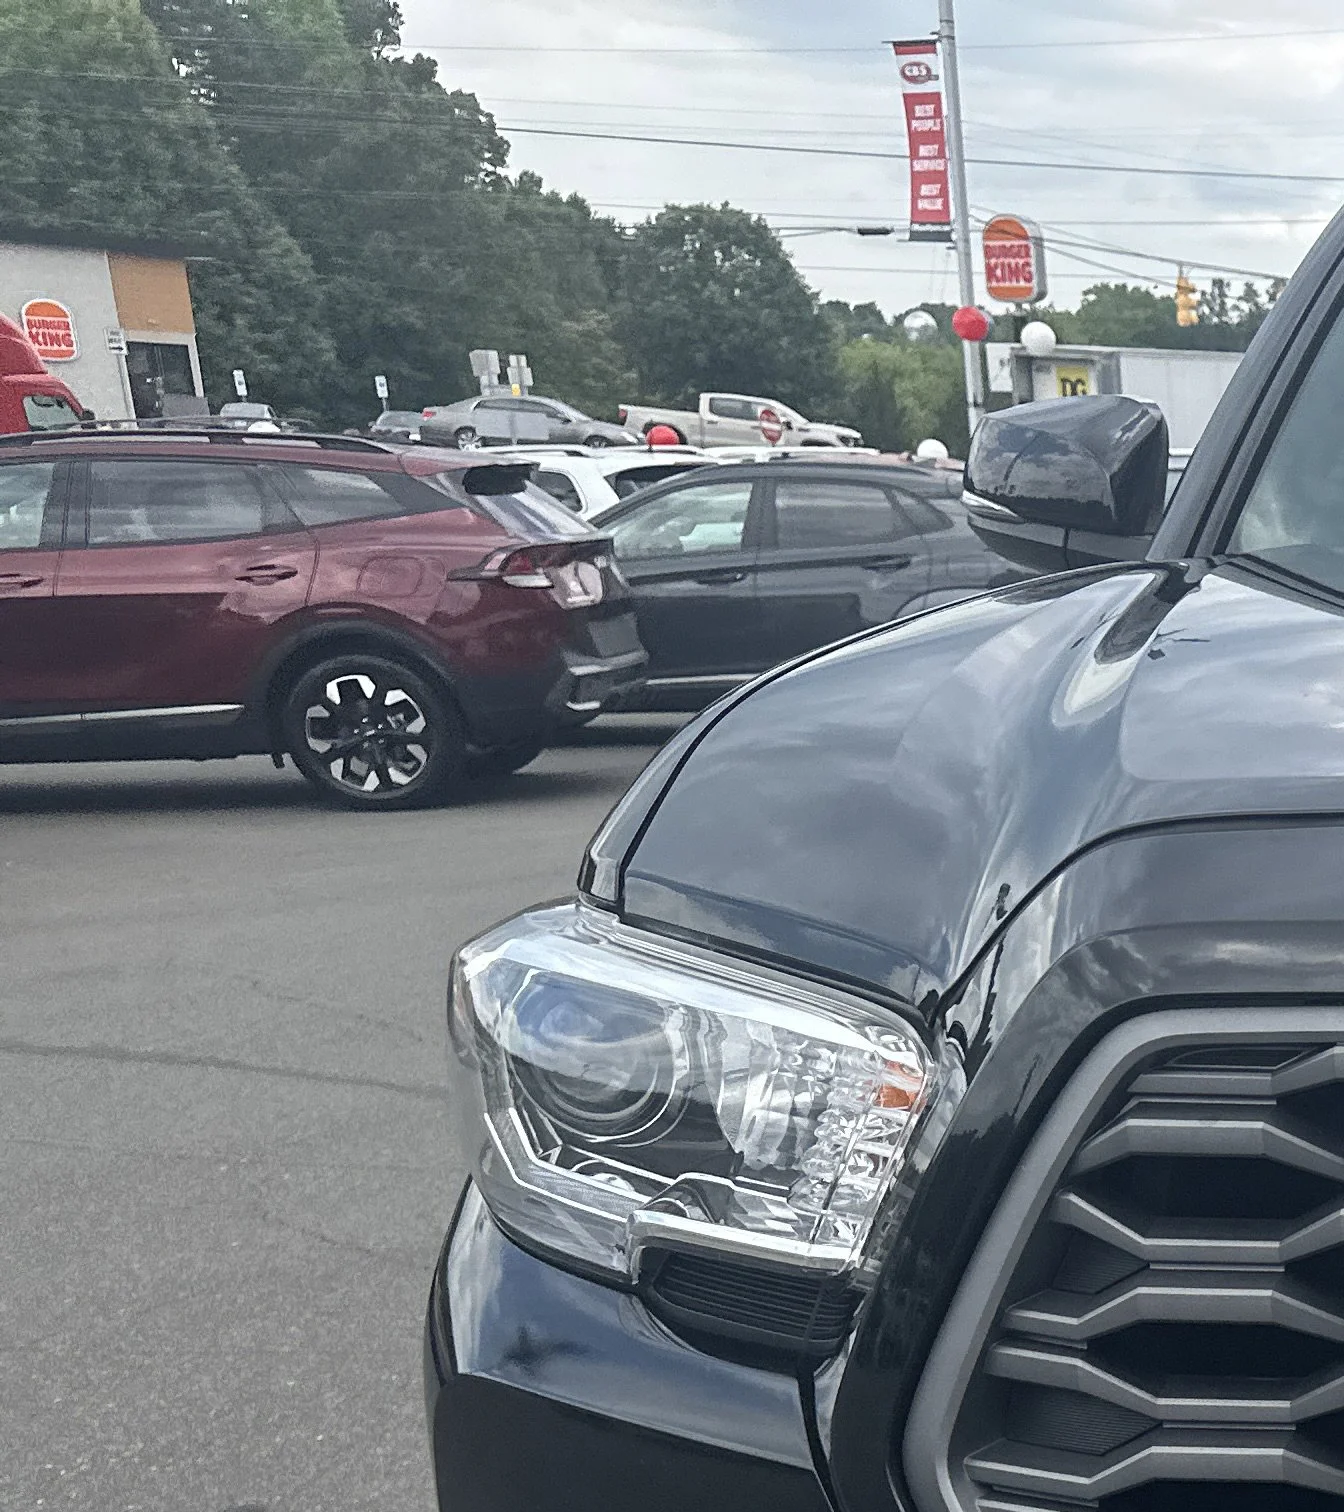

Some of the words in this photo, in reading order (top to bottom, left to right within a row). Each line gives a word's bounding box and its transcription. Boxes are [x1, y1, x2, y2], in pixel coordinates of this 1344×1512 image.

[986, 261, 1033, 284] KING
[29, 330, 74, 347] KING
[1060, 377, 1087, 397] DG
